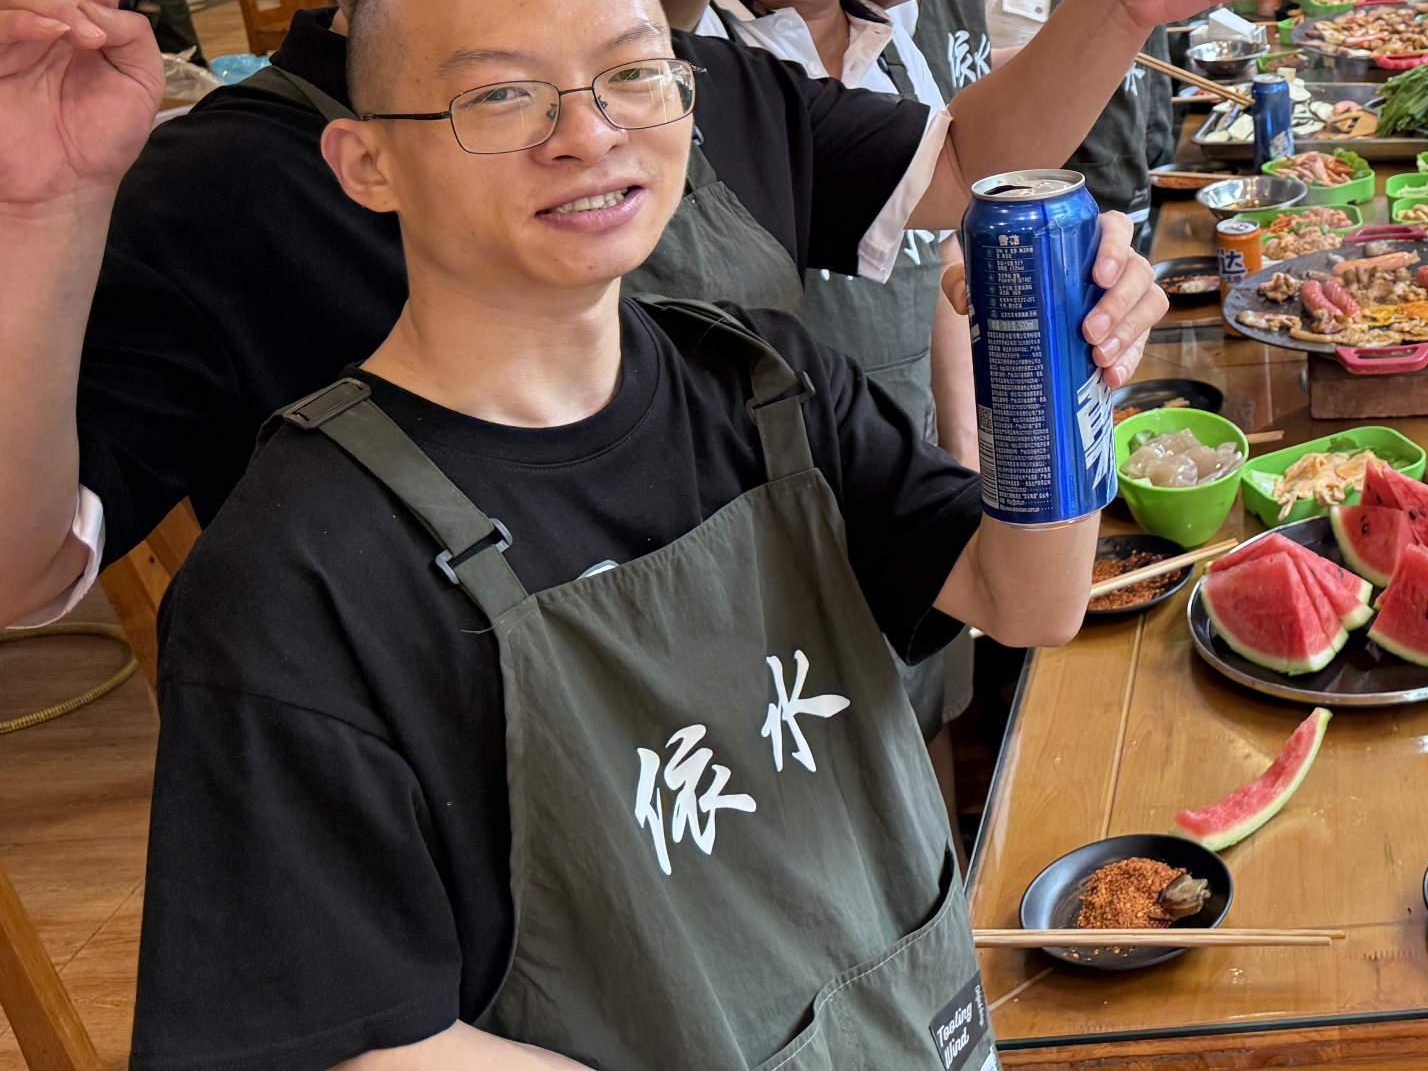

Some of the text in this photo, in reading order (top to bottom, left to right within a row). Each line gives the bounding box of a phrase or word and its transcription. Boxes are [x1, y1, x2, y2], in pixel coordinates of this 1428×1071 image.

[634, 649, 851, 875] 依水
[936, 1002, 973, 1048] Tooling
[944, 1026, 970, 1069] Wind
